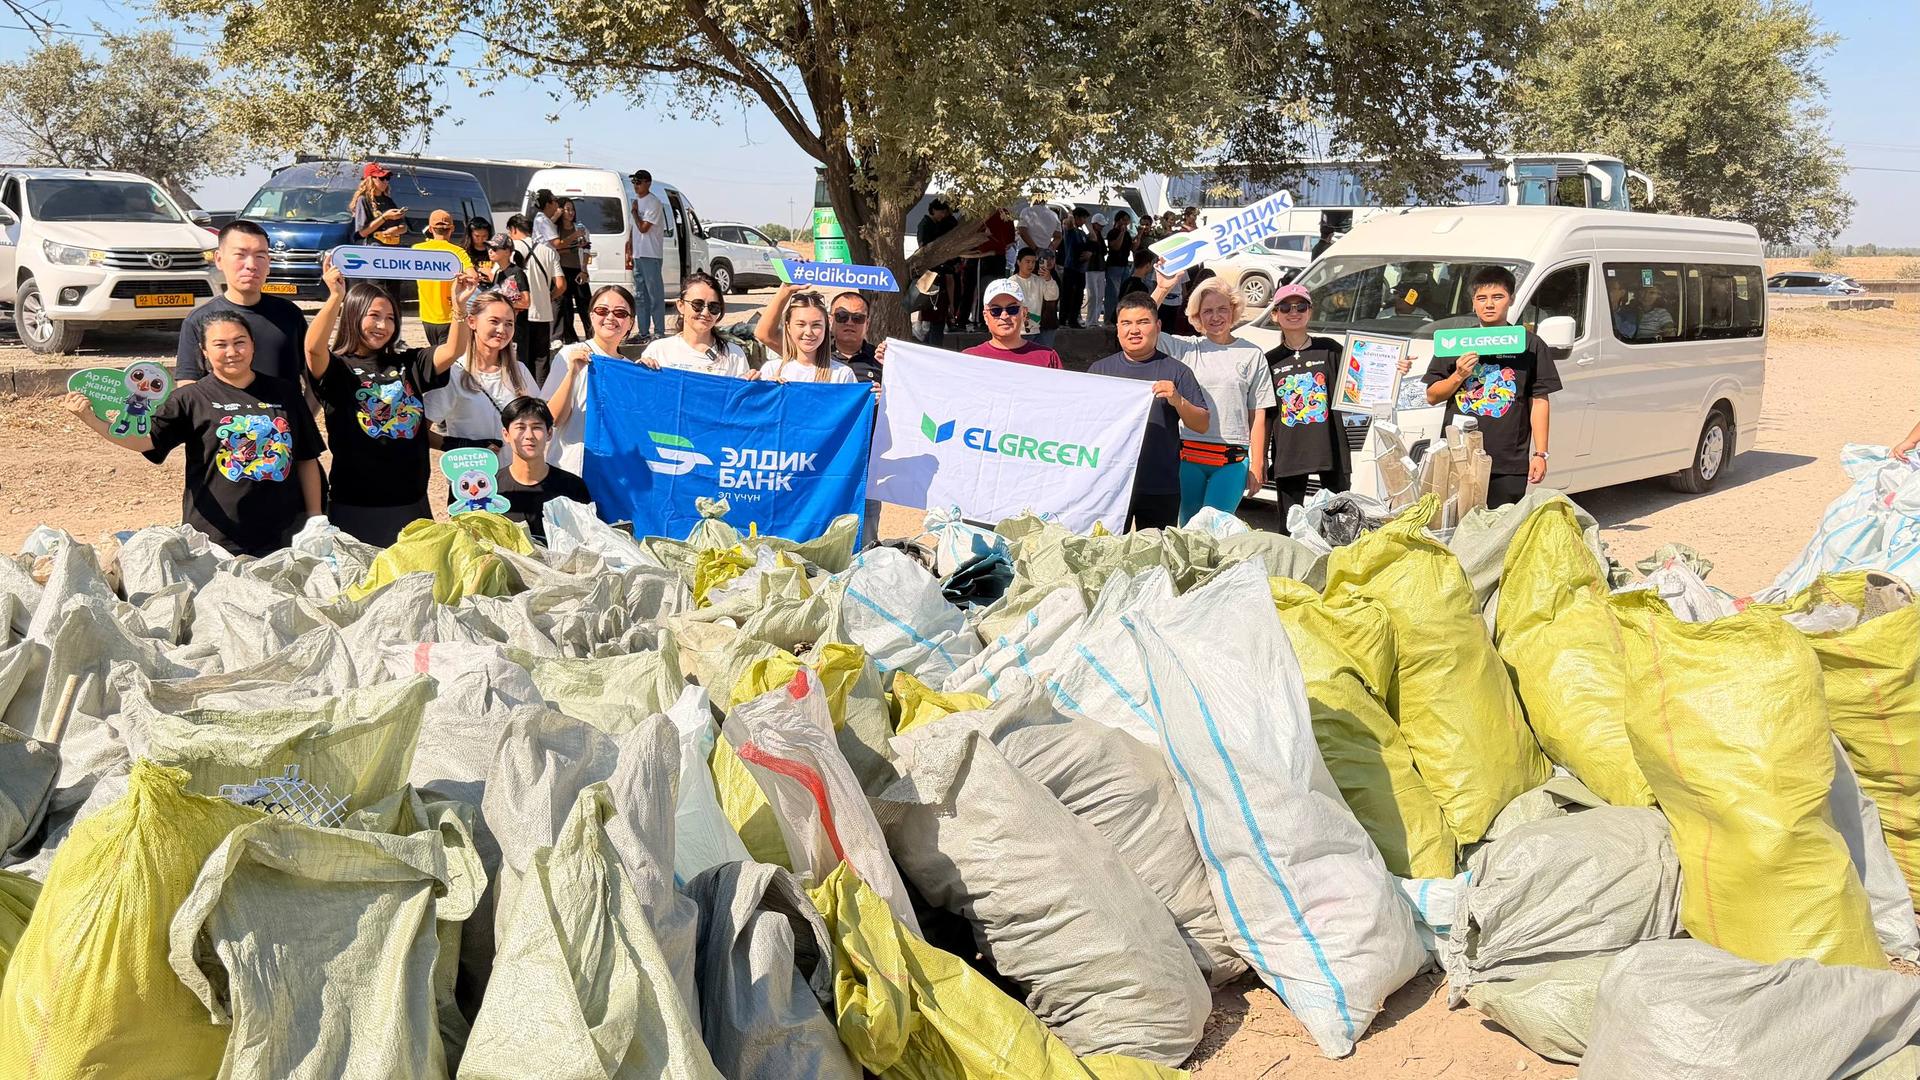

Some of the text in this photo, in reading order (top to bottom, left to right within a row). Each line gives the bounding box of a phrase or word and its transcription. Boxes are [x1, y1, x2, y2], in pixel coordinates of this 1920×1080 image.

[1210, 192, 1290, 240] ЭЛДИК
[1215, 217, 1279, 256] БАНК
[373, 258, 451, 272] ELDIK BANK
[793, 266, 889, 286] #eldikbank
[1459, 334, 1519, 347] ELGREEN
[83, 380, 117, 394] жанга
[85, 371, 122, 387] Ар бир
[88, 389, 123, 405] керек!
[963, 427, 1101, 469] ELGREEN
[719, 446, 818, 472] ЭЛДИК
[718, 468, 795, 491] БАНК
[718, 491, 761, 503] эл үчүн
